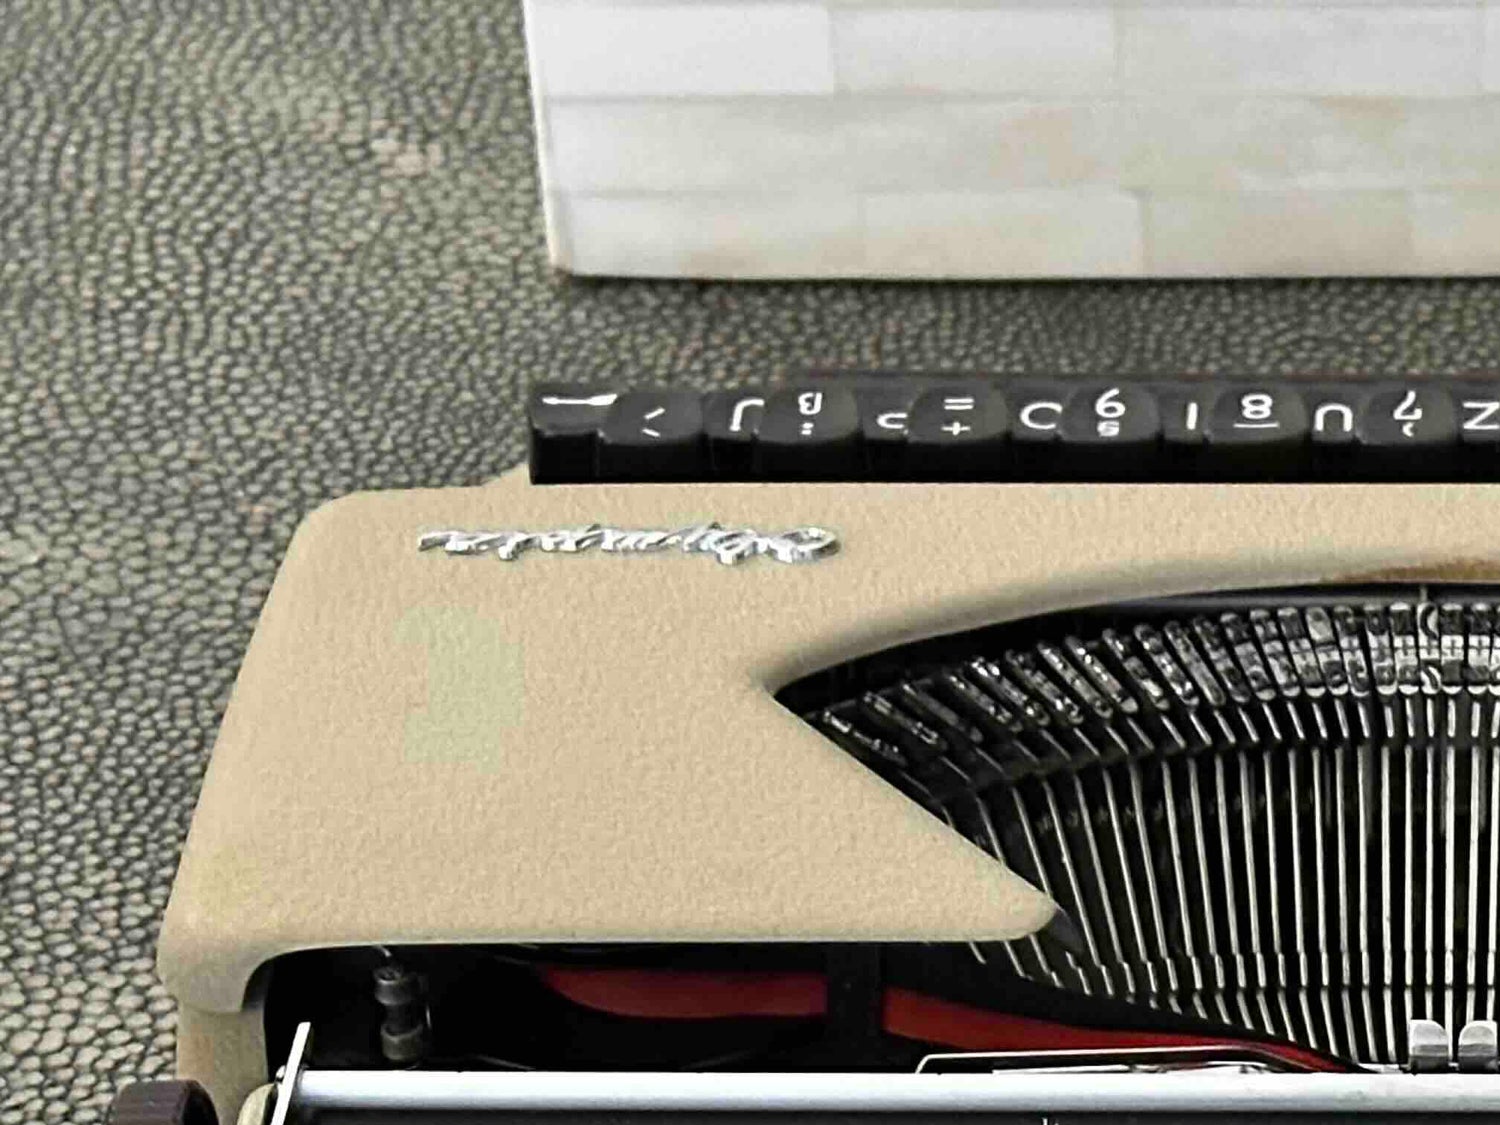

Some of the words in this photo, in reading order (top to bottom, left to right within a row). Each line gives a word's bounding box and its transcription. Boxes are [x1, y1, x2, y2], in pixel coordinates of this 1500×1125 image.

[1094, 387, 1126, 419] 9
[1241, 393, 1274, 420] 8
[1313, 402, 1354, 433] U
[1392, 390, 1423, 420] 7
[1462, 400, 1500, 431] Z
